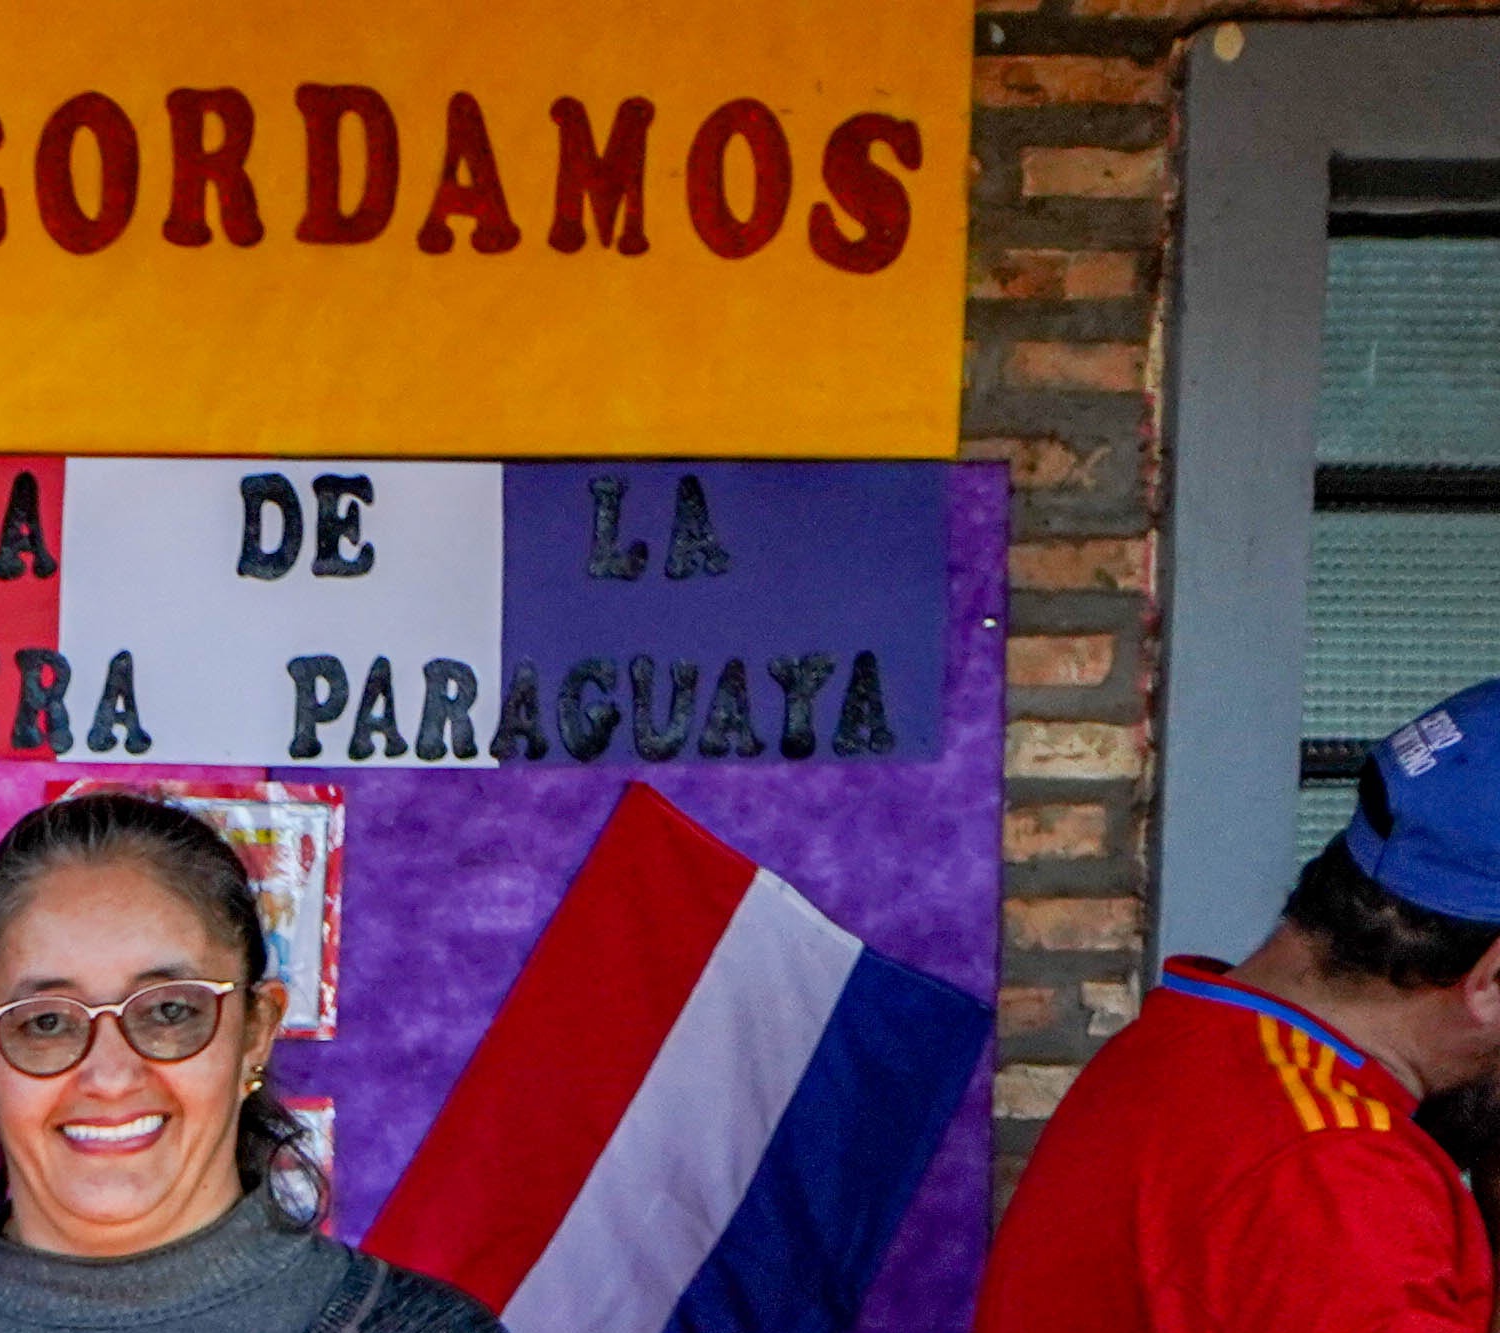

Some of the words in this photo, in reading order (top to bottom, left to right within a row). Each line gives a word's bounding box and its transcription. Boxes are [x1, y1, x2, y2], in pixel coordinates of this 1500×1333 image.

[235, 472, 376, 580] DE
[585, 473, 731, 579] LA
[285, 648, 897, 762] PARAGUAYA
